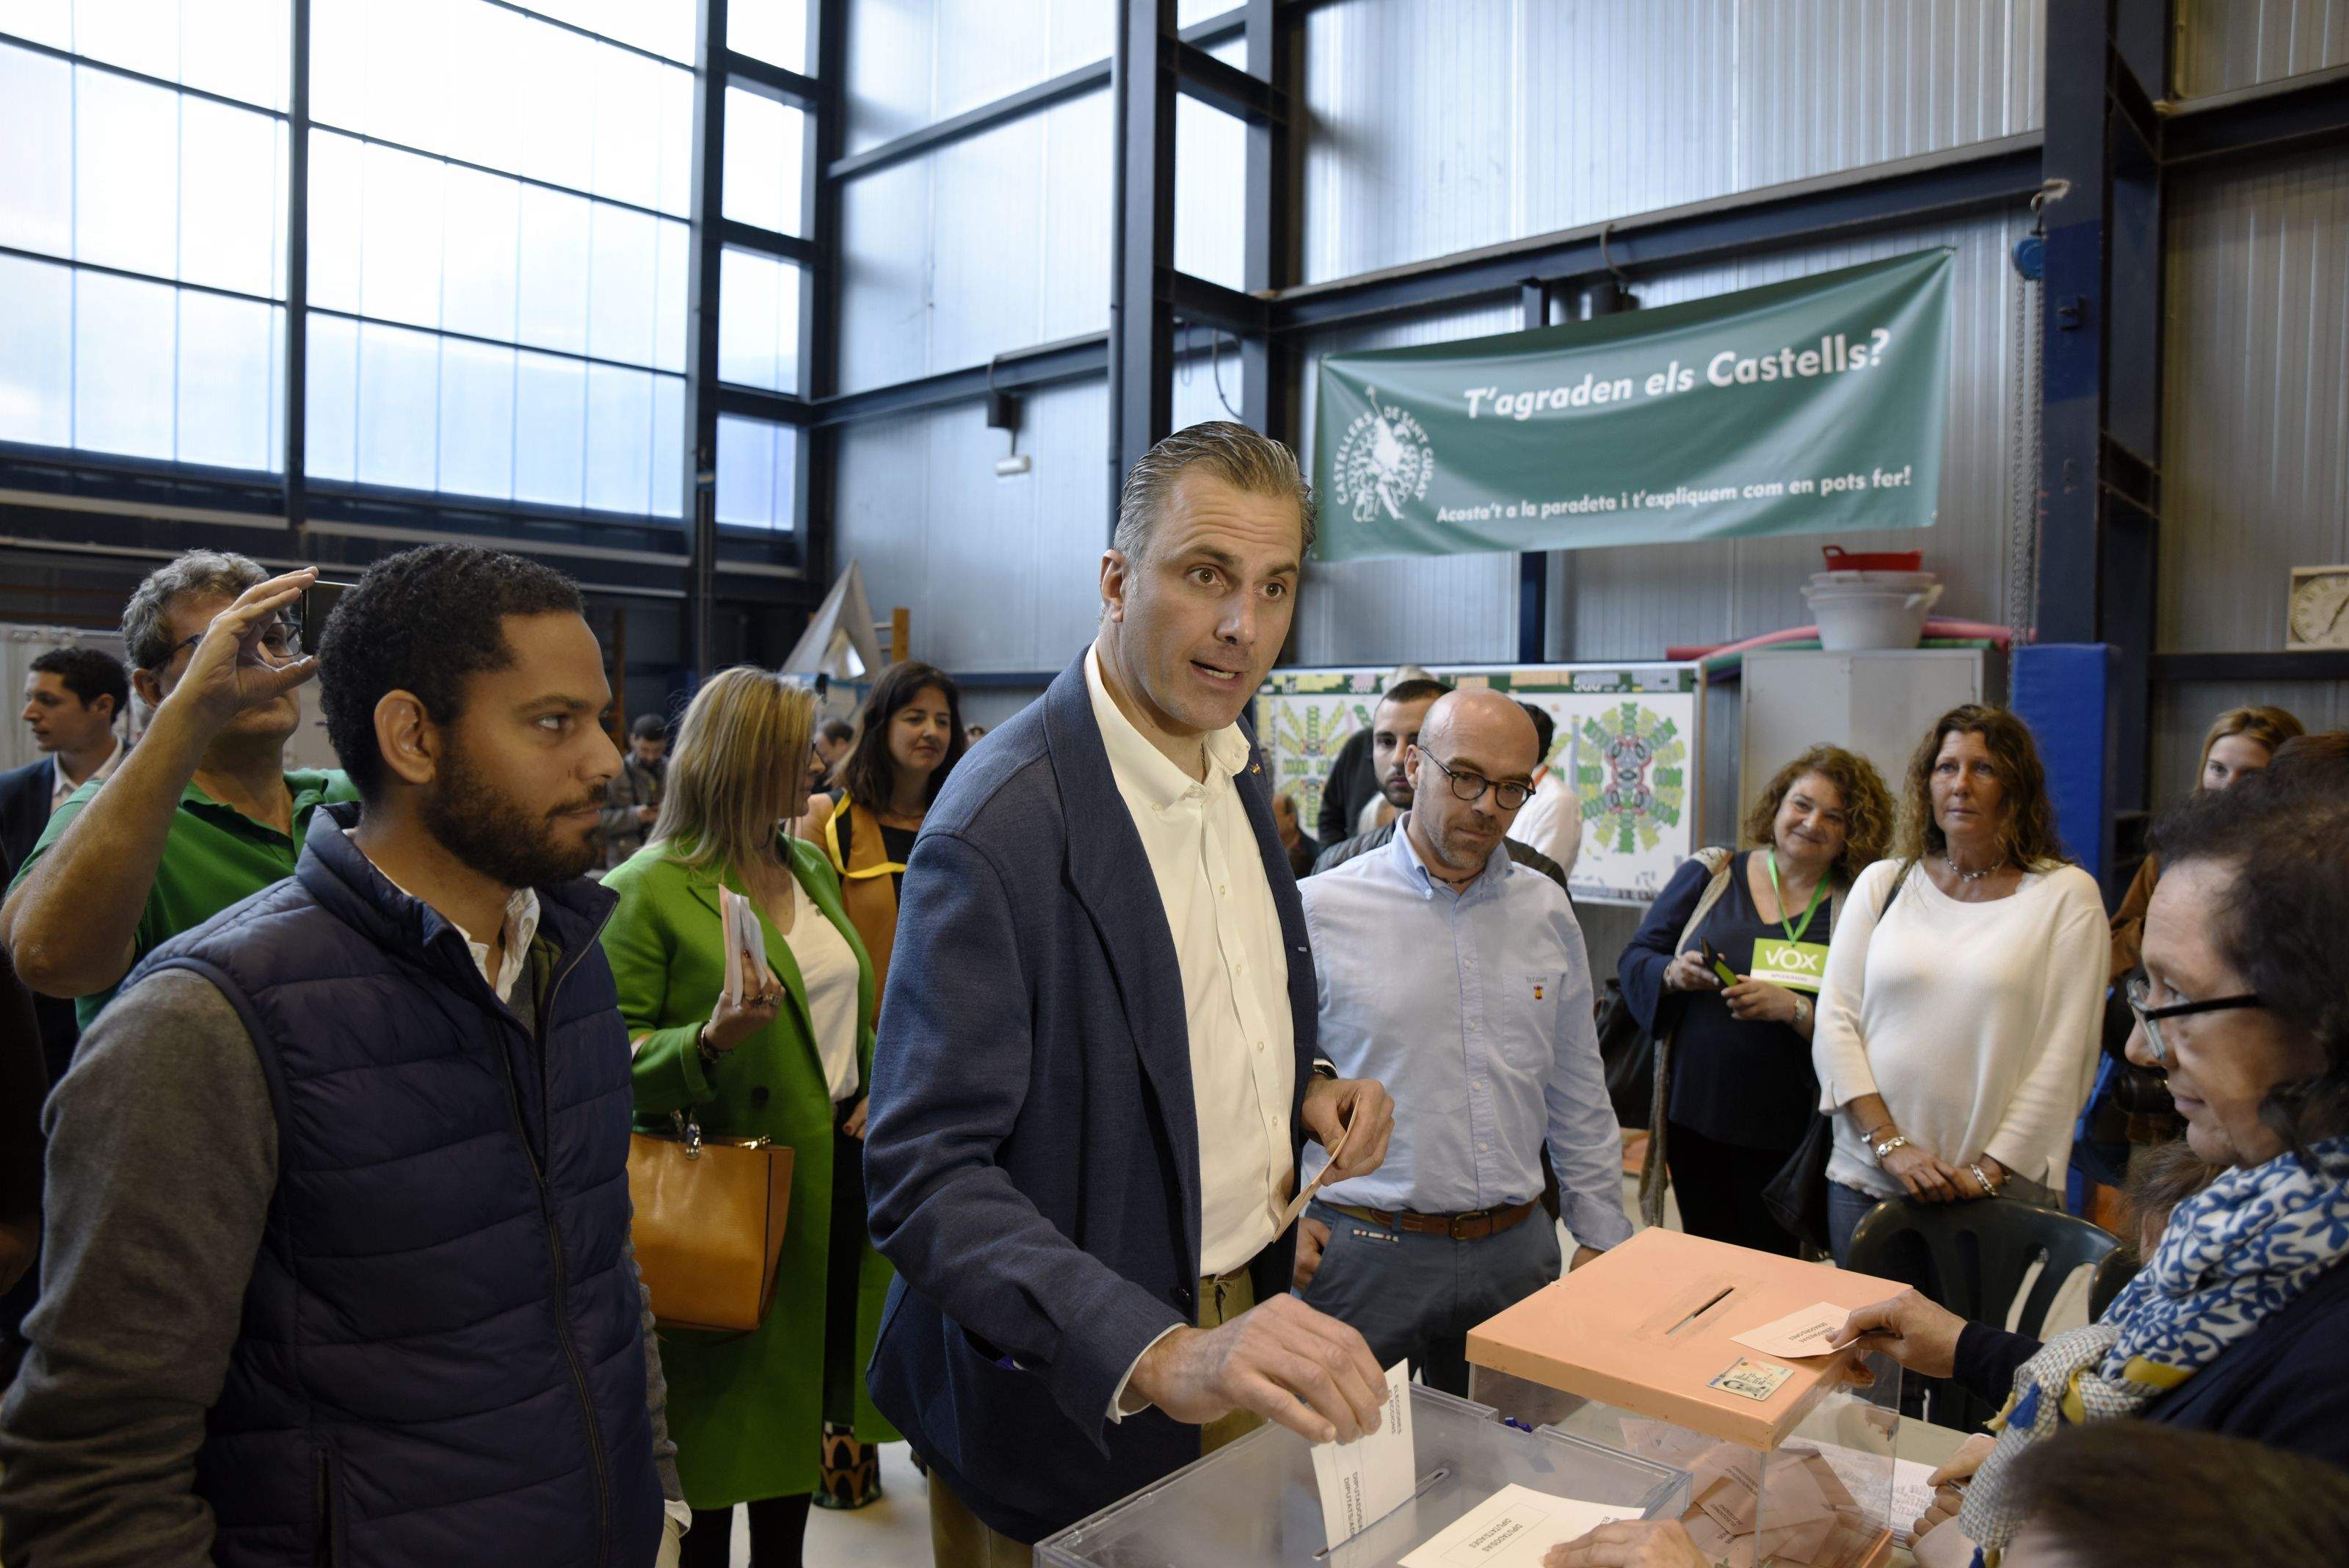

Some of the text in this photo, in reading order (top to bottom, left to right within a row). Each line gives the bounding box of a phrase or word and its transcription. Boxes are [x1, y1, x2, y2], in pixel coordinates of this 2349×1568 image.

[1463, 327, 1891, 421] T'agraden els Castells?
[1384, 405, 1401, 421] DE
[1436, 465, 1911, 523] Acosta't a la paradeta i t'expliquem com en pots fer!
[1765, 946, 1819, 971] VOX
[1352, 1471, 1363, 1533] DIPUTADOS/A
